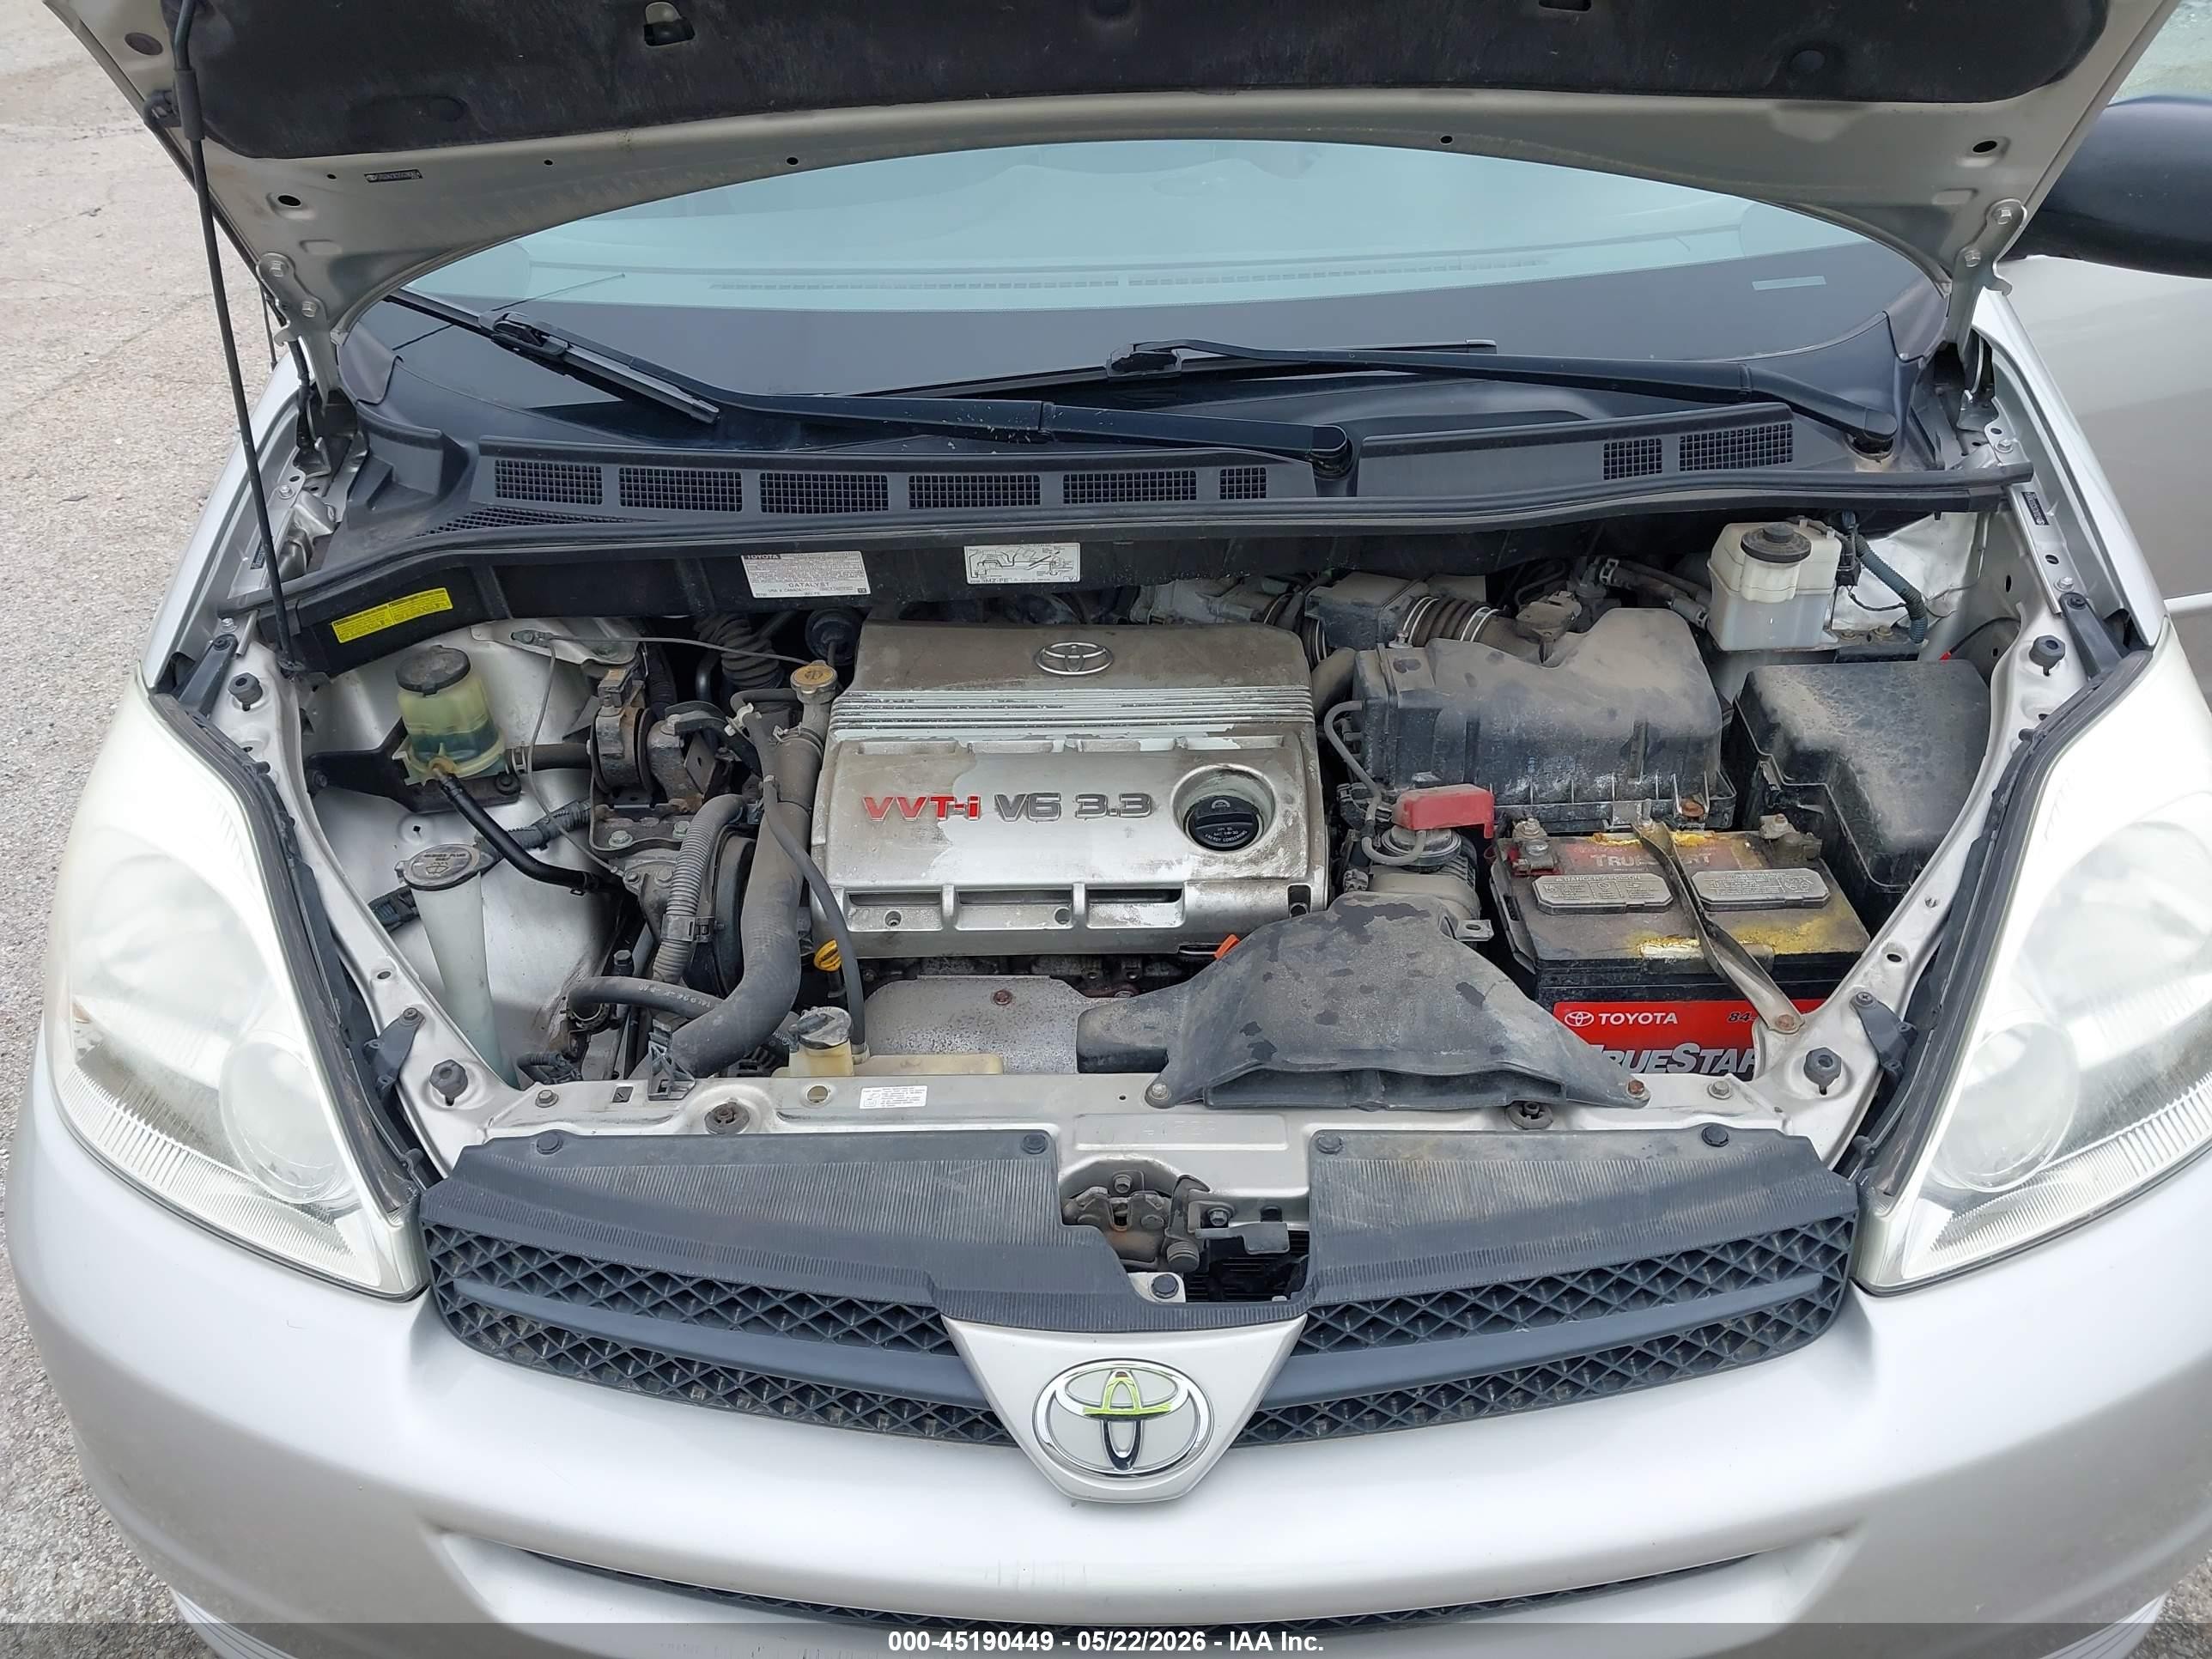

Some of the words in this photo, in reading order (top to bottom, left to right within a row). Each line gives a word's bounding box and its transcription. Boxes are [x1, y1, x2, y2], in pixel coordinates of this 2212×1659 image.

[863, 795, 981, 822] VVT-i
[994, 793, 1061, 822] V6
[1075, 793, 1152, 819] 3.3
[1599, 1012, 1678, 1025] TOYOTA
